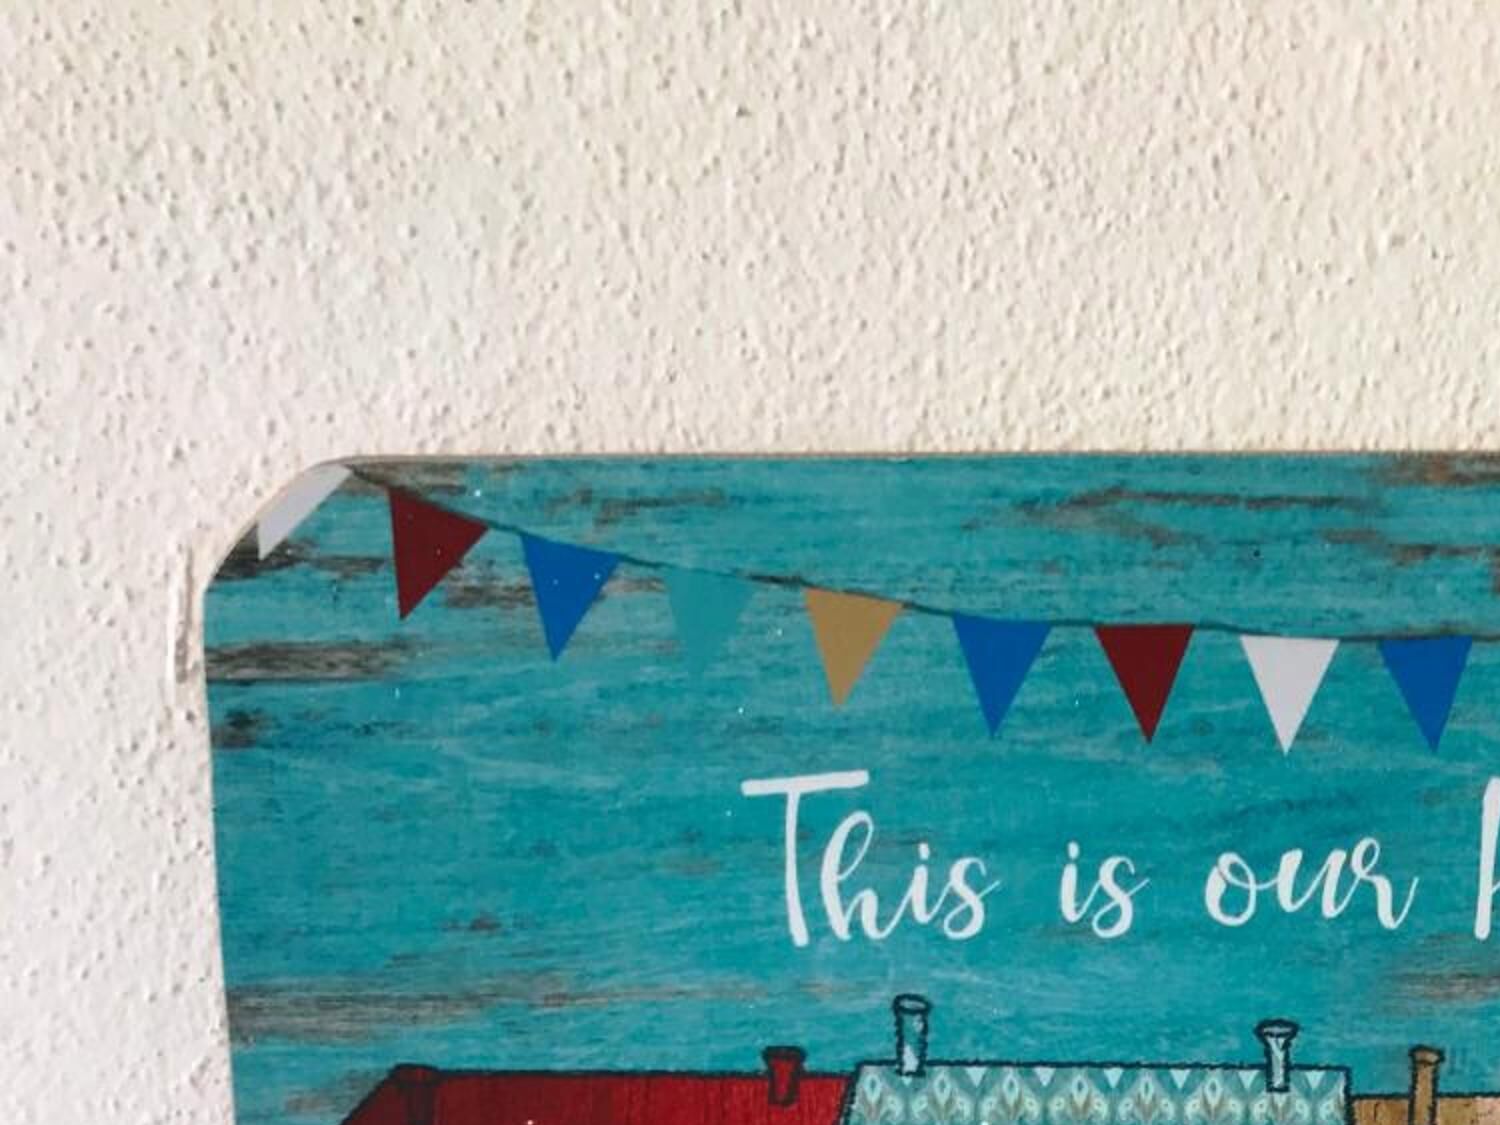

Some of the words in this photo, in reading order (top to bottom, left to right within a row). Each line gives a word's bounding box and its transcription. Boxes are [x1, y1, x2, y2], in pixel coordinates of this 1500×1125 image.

[740, 768, 1001, 946] This
[1060, 841, 1148, 939] is
[1204, 837, 1418, 930] our
